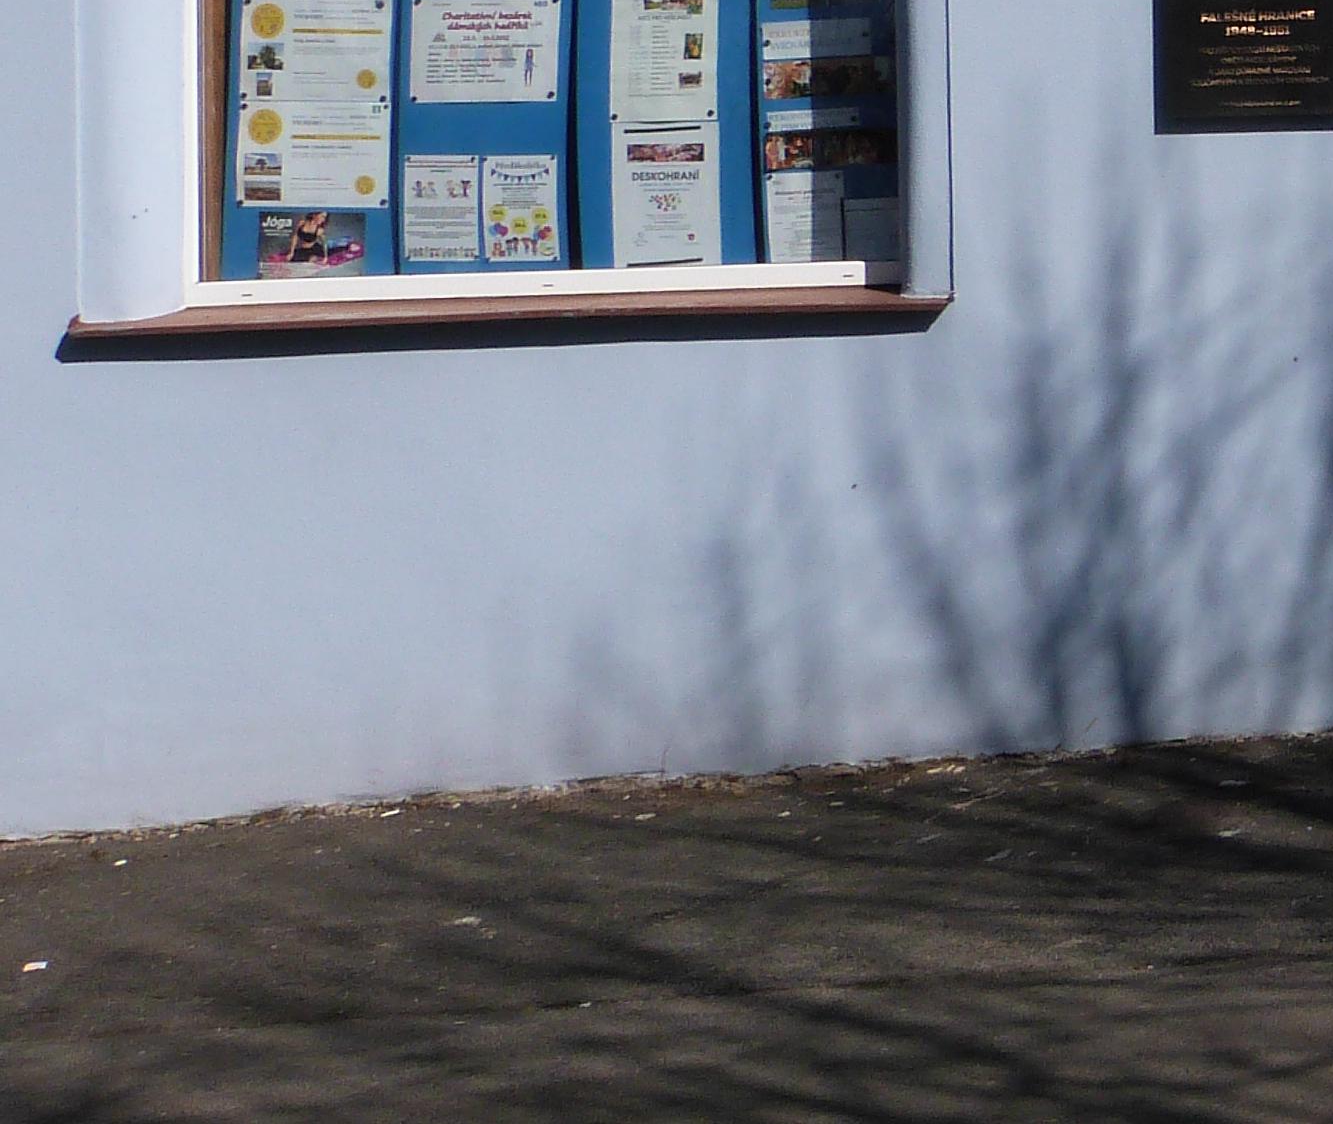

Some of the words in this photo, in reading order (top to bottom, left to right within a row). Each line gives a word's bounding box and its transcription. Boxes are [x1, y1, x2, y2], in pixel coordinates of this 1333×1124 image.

[1200, 8, 1257, 23] FALEŠNÉ
[1258, 9, 1316, 22] HRANICE
[631, 169, 700, 181] DESKOHRANÍ
[261, 215, 293, 229] Jóga
